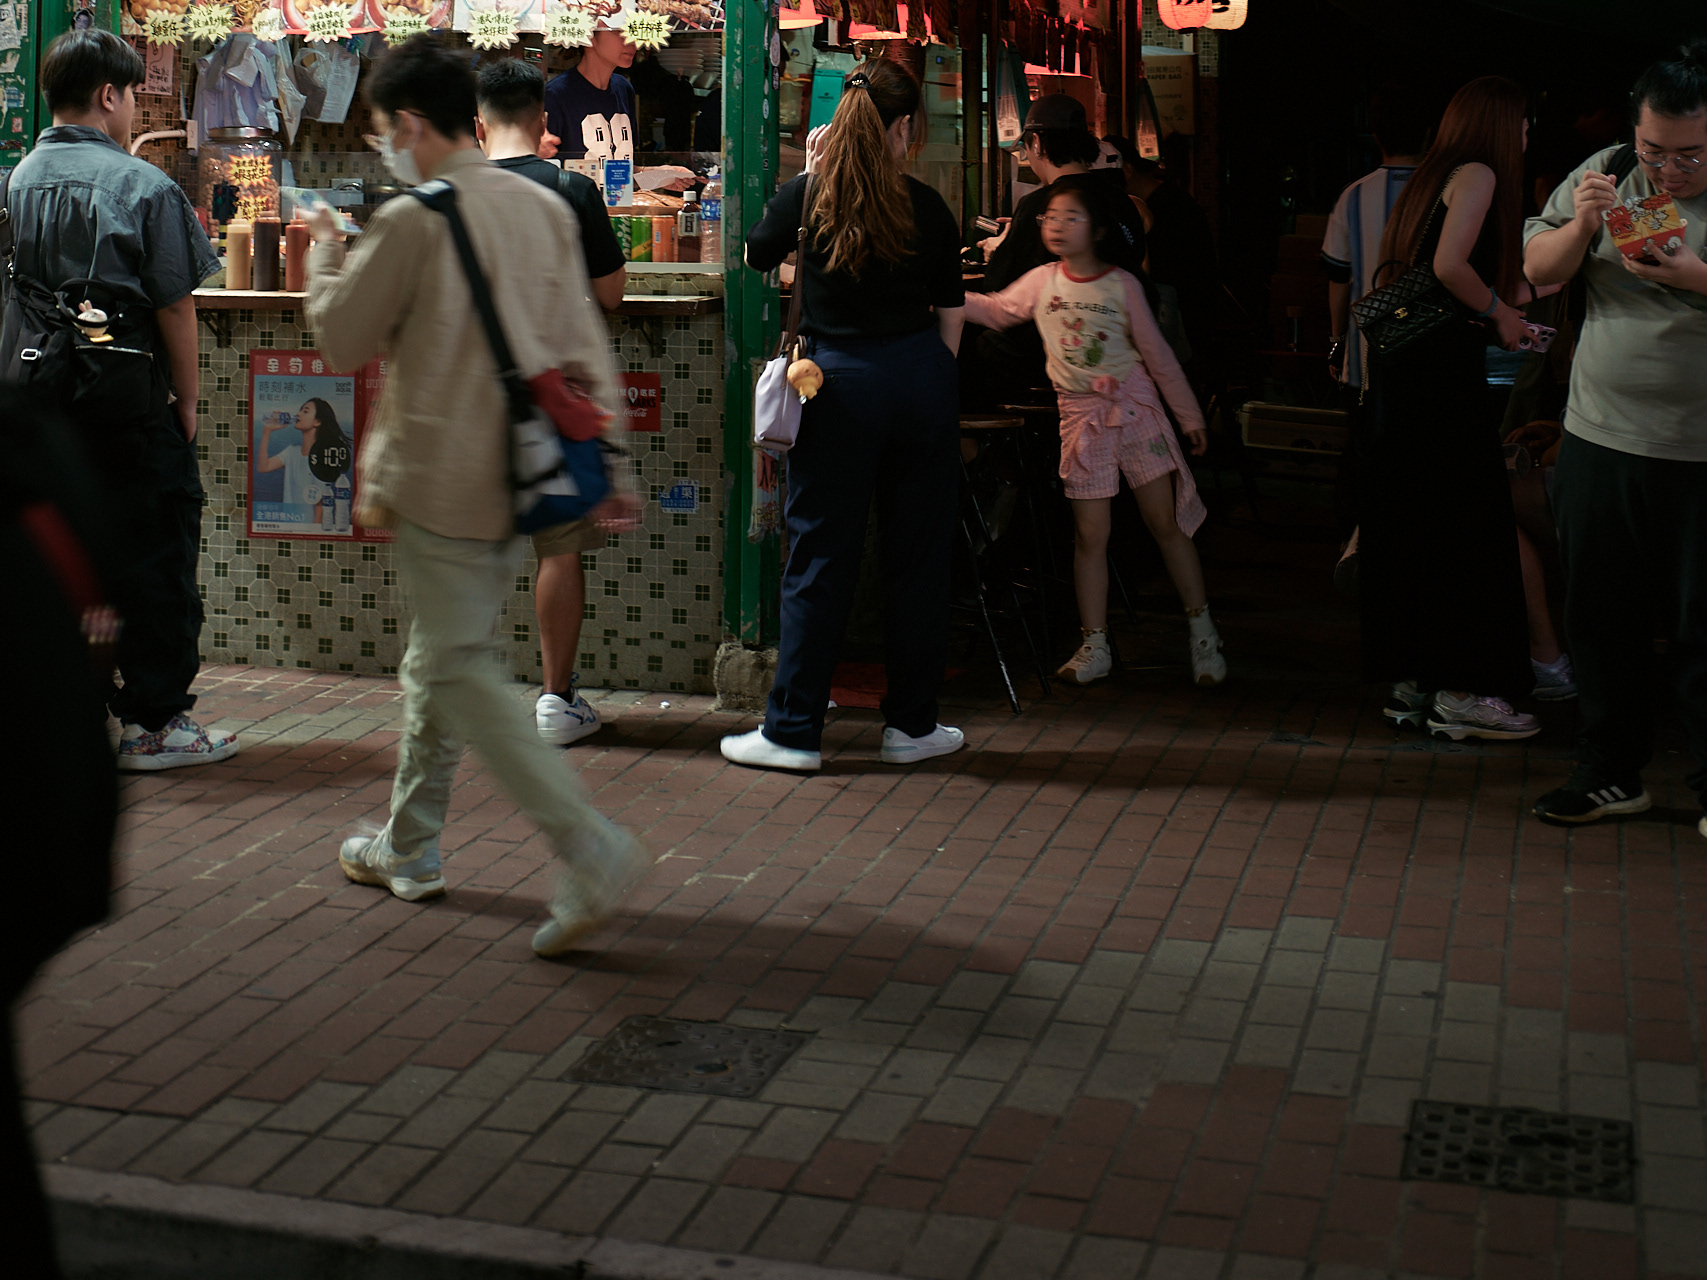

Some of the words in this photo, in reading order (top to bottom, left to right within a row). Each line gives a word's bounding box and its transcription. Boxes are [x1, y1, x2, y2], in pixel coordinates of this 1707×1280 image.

[266, 358, 342, 375] 至筍推
[258, 381, 307, 394] 時刻補水
